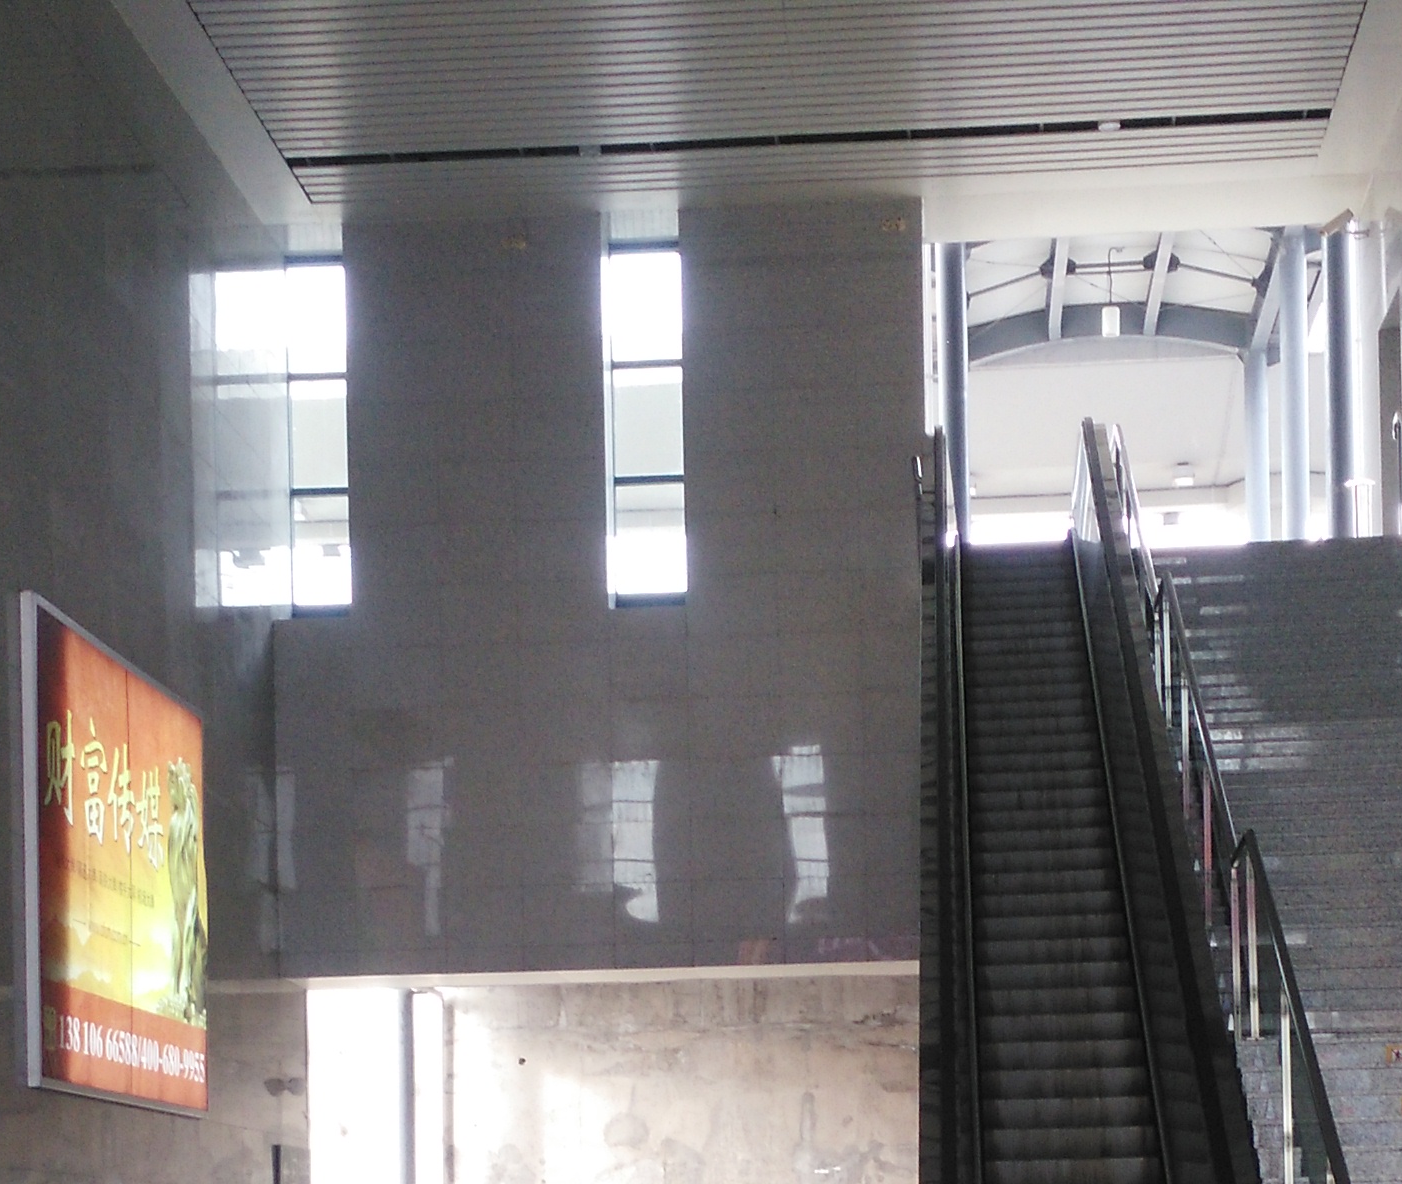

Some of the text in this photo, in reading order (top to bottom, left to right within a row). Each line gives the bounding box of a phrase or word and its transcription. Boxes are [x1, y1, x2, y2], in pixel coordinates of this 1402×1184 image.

[44, 709, 166, 871] 财富传媒
[60, 1015, 81, 1054] 138
[83, 1021, 104, 1059] 106
[105, 1027, 206, 1084] 66588/400-680-9955
